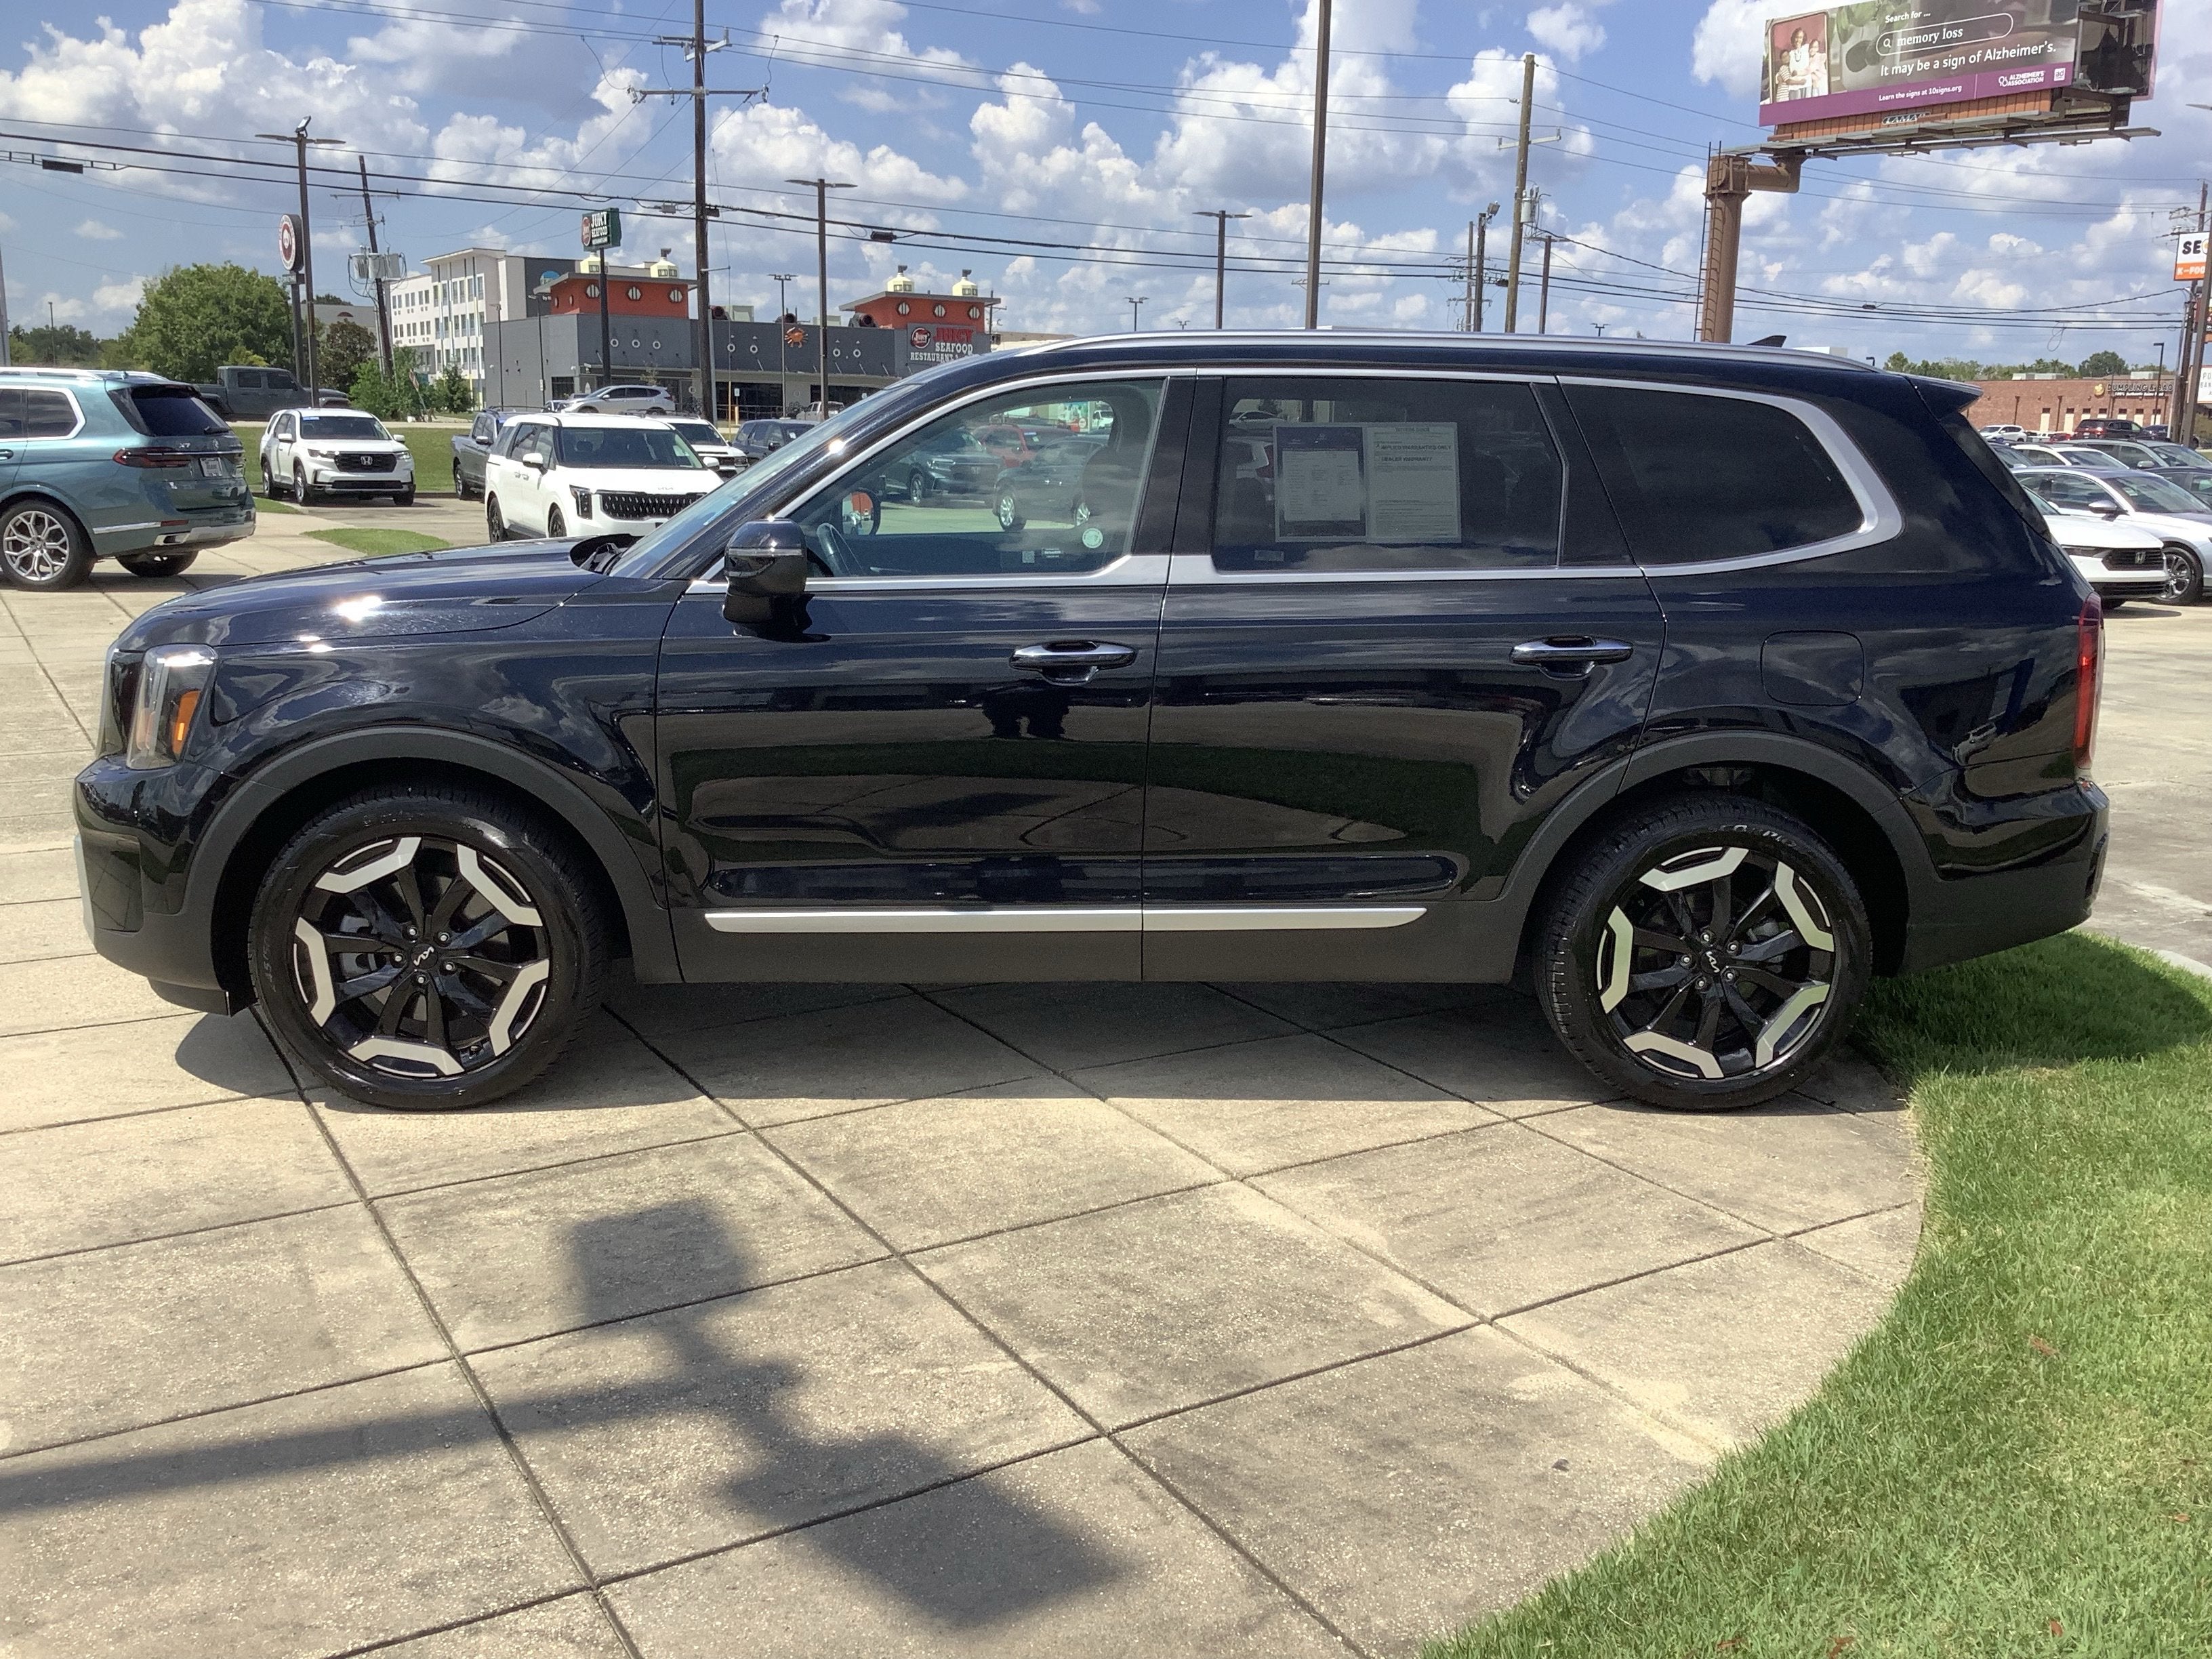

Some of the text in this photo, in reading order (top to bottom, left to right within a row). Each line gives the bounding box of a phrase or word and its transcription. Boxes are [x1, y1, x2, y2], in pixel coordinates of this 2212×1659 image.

[1885, 12, 1909, 24] Search
[1911, 10, 1922, 19] for
[1897, 28, 1963, 47] memory loss
[1881, 41, 2056, 77] It may be a sign of Alzheimer's.
[2007, 77, 2044, 87] ASSOCIATION
[1906, 90, 1921, 98] signs
[1929, 85, 1963, 96] 10signs.org
[591, 211, 607, 228] JUICY
[2177, 265, 2205, 276] K-FOO
[933, 327, 974, 343] JUICY
[935, 342, 973, 356] SEAFOOD
[910, 352, 954, 363] RESTAURANT
[2106, 383, 2148, 392] DUMPLING
